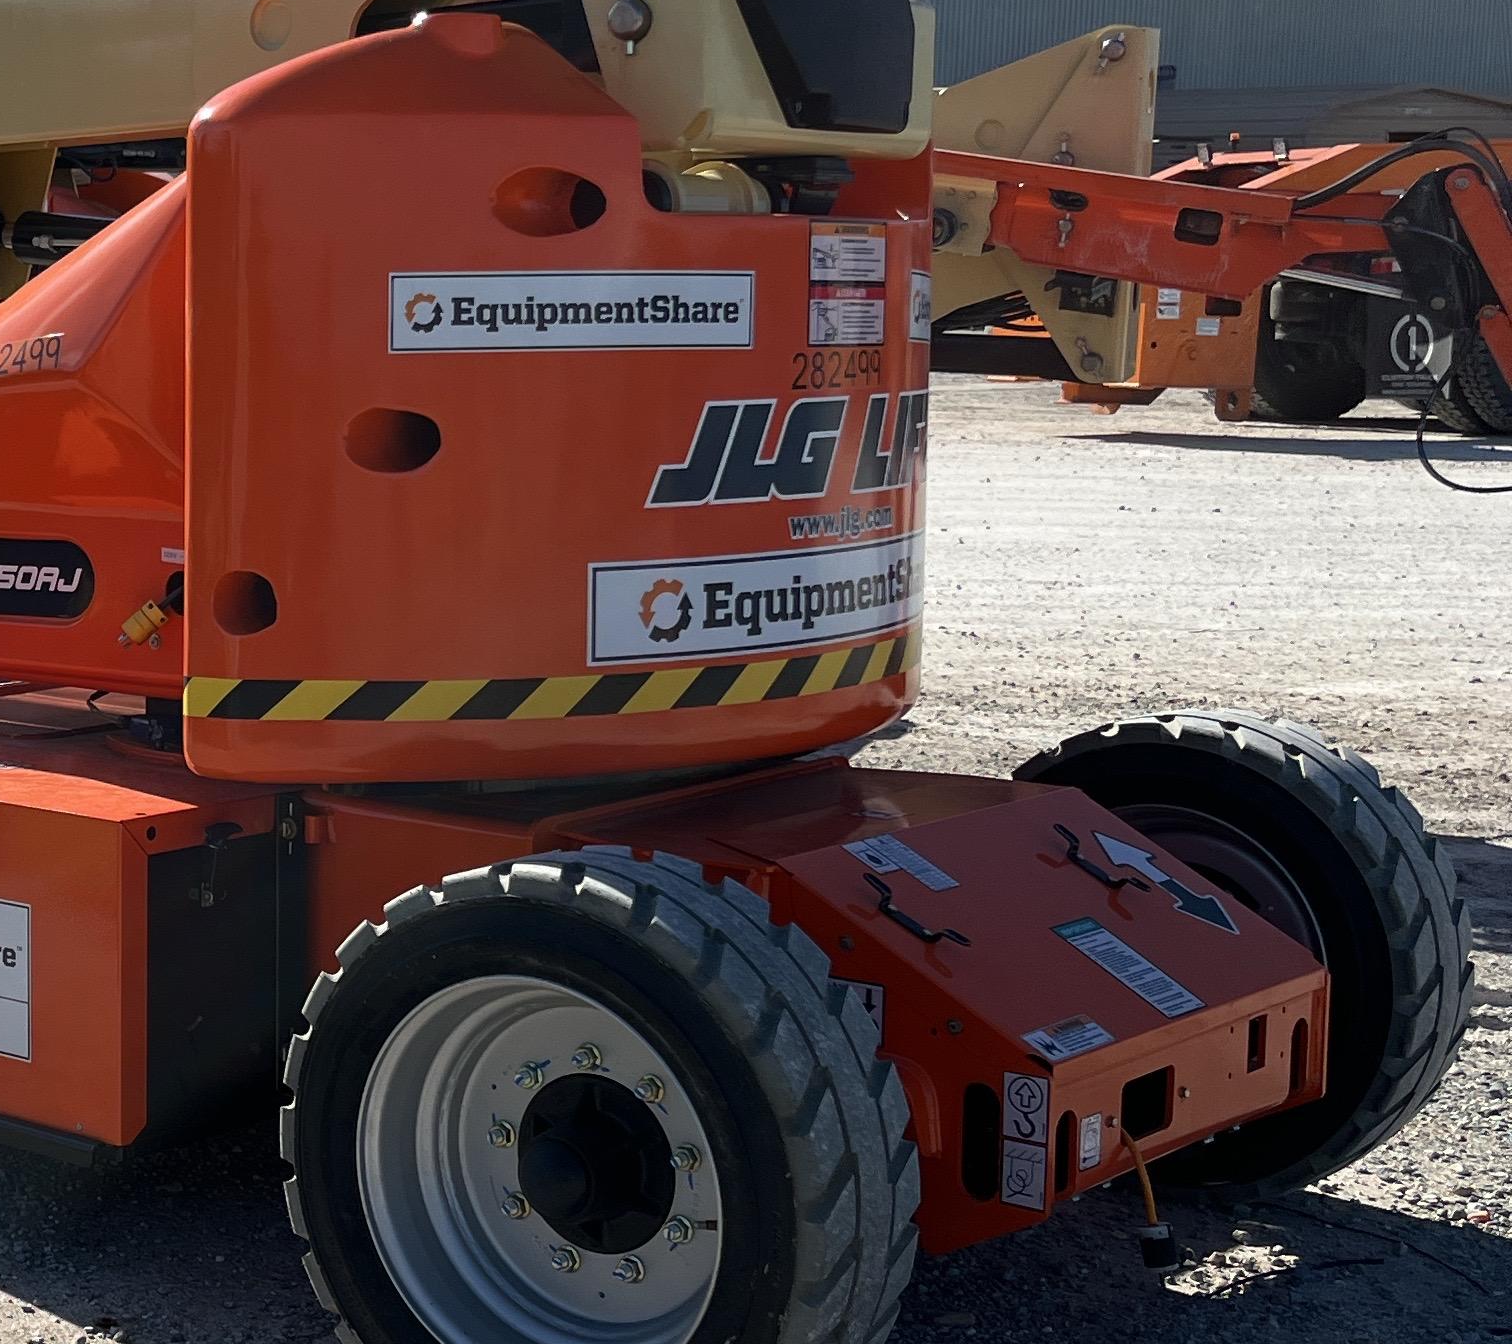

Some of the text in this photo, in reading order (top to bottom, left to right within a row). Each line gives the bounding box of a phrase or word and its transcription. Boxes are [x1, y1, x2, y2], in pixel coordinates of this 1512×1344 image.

[450, 295, 740, 333] EquipmentShare
[791, 349, 882, 390] 282499
[644, 395, 850, 508] JLG
[788, 506, 893, 541] www.jlg.com
